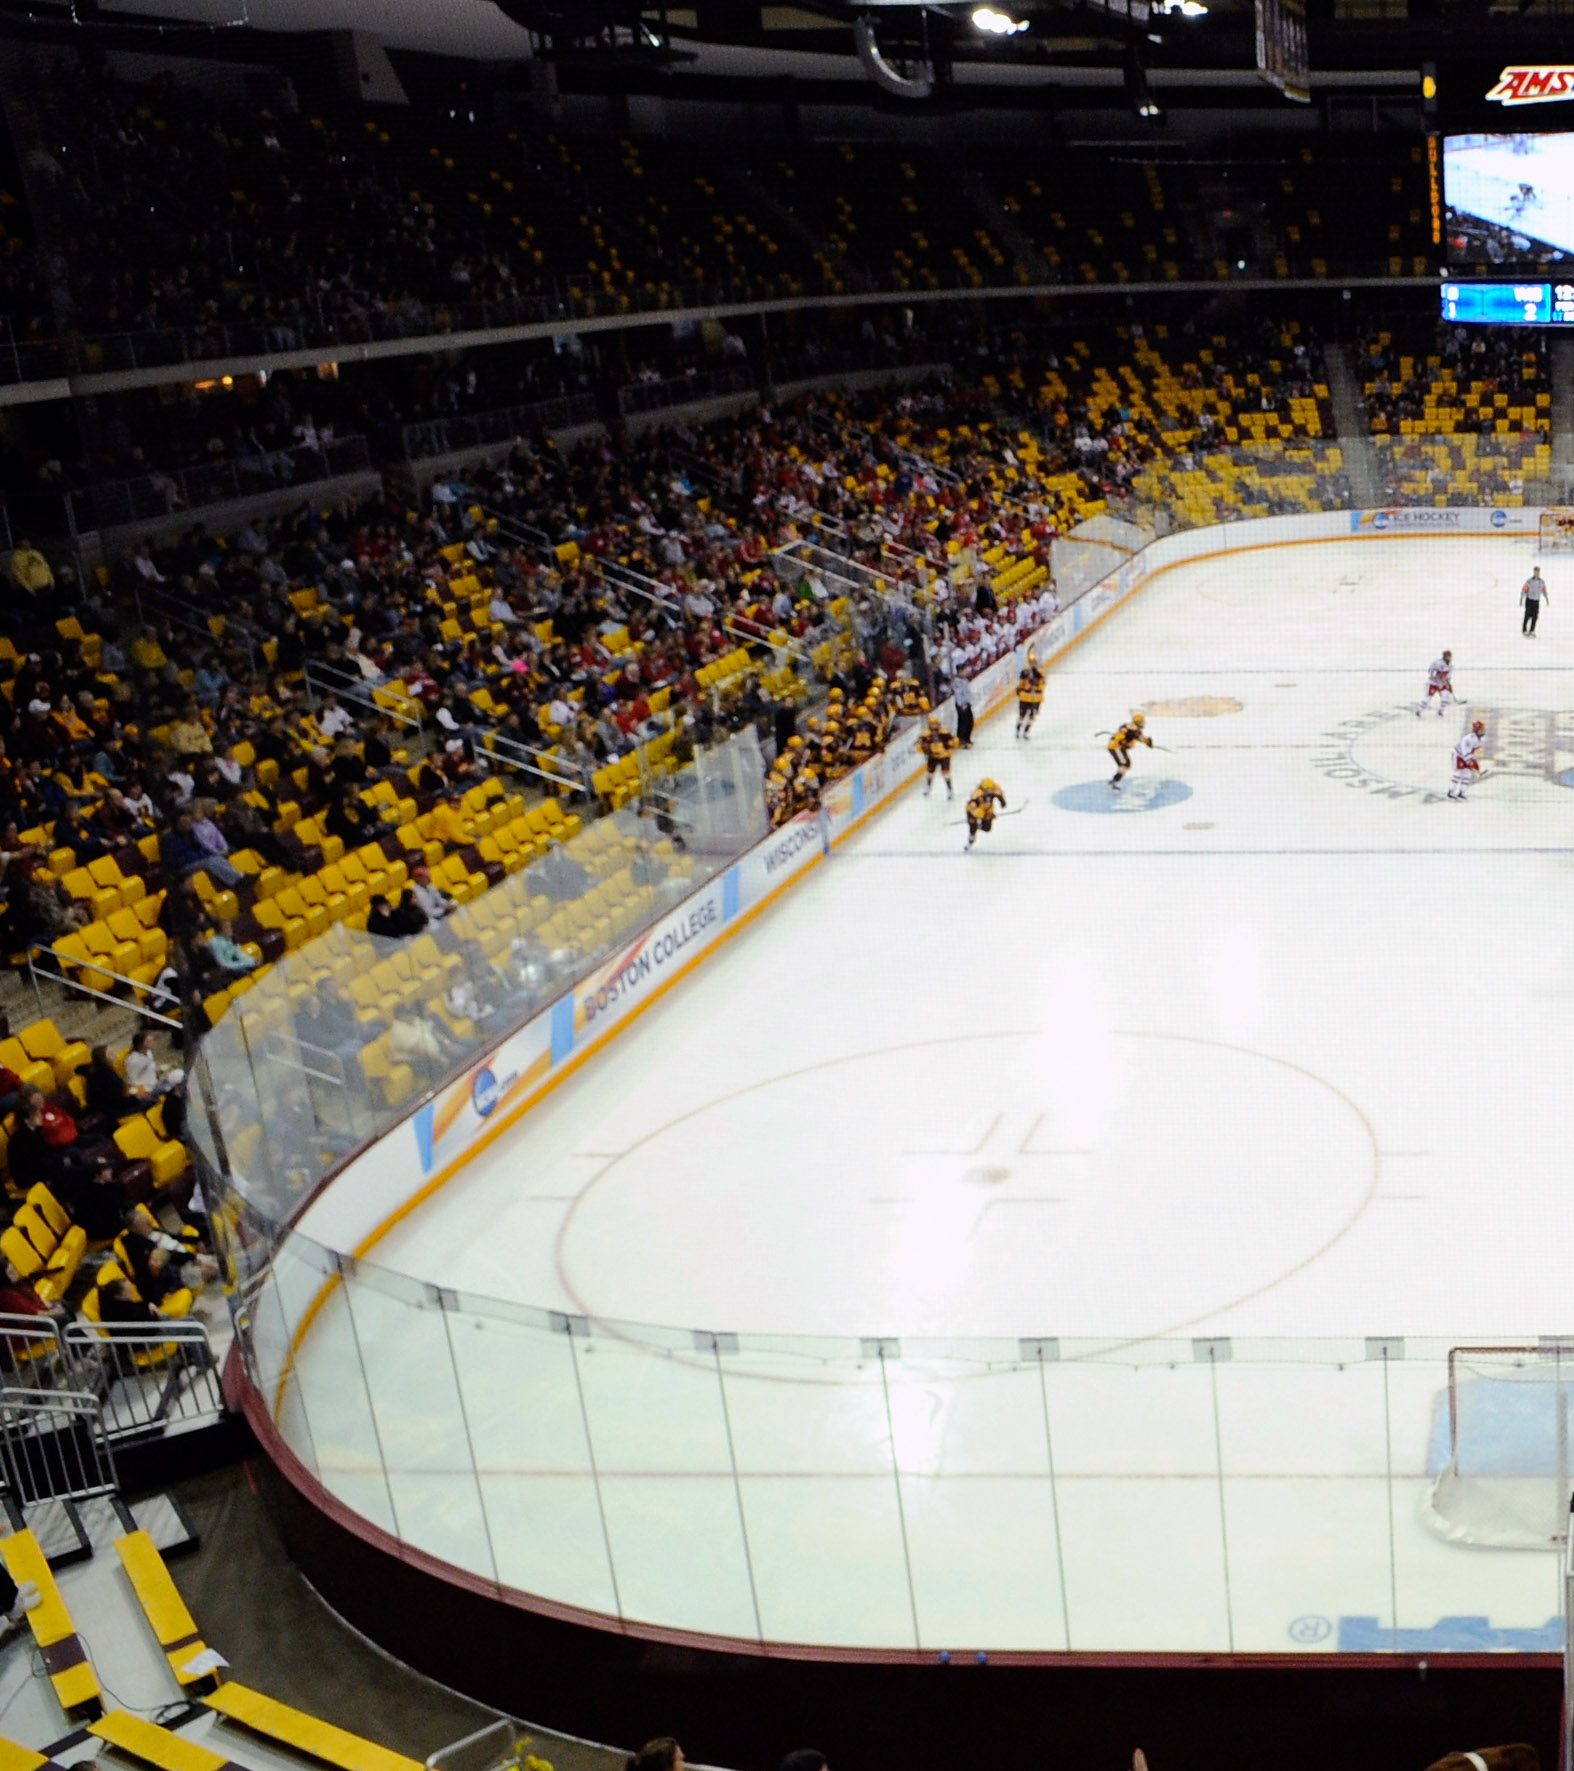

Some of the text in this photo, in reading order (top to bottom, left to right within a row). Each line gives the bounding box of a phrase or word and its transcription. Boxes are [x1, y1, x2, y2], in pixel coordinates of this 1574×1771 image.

[1524, 303, 1537, 321] 2
[1413, 510, 1461, 523] HOCKEY
[583, 899, 718, 1022] BOSTON COLLEGE
